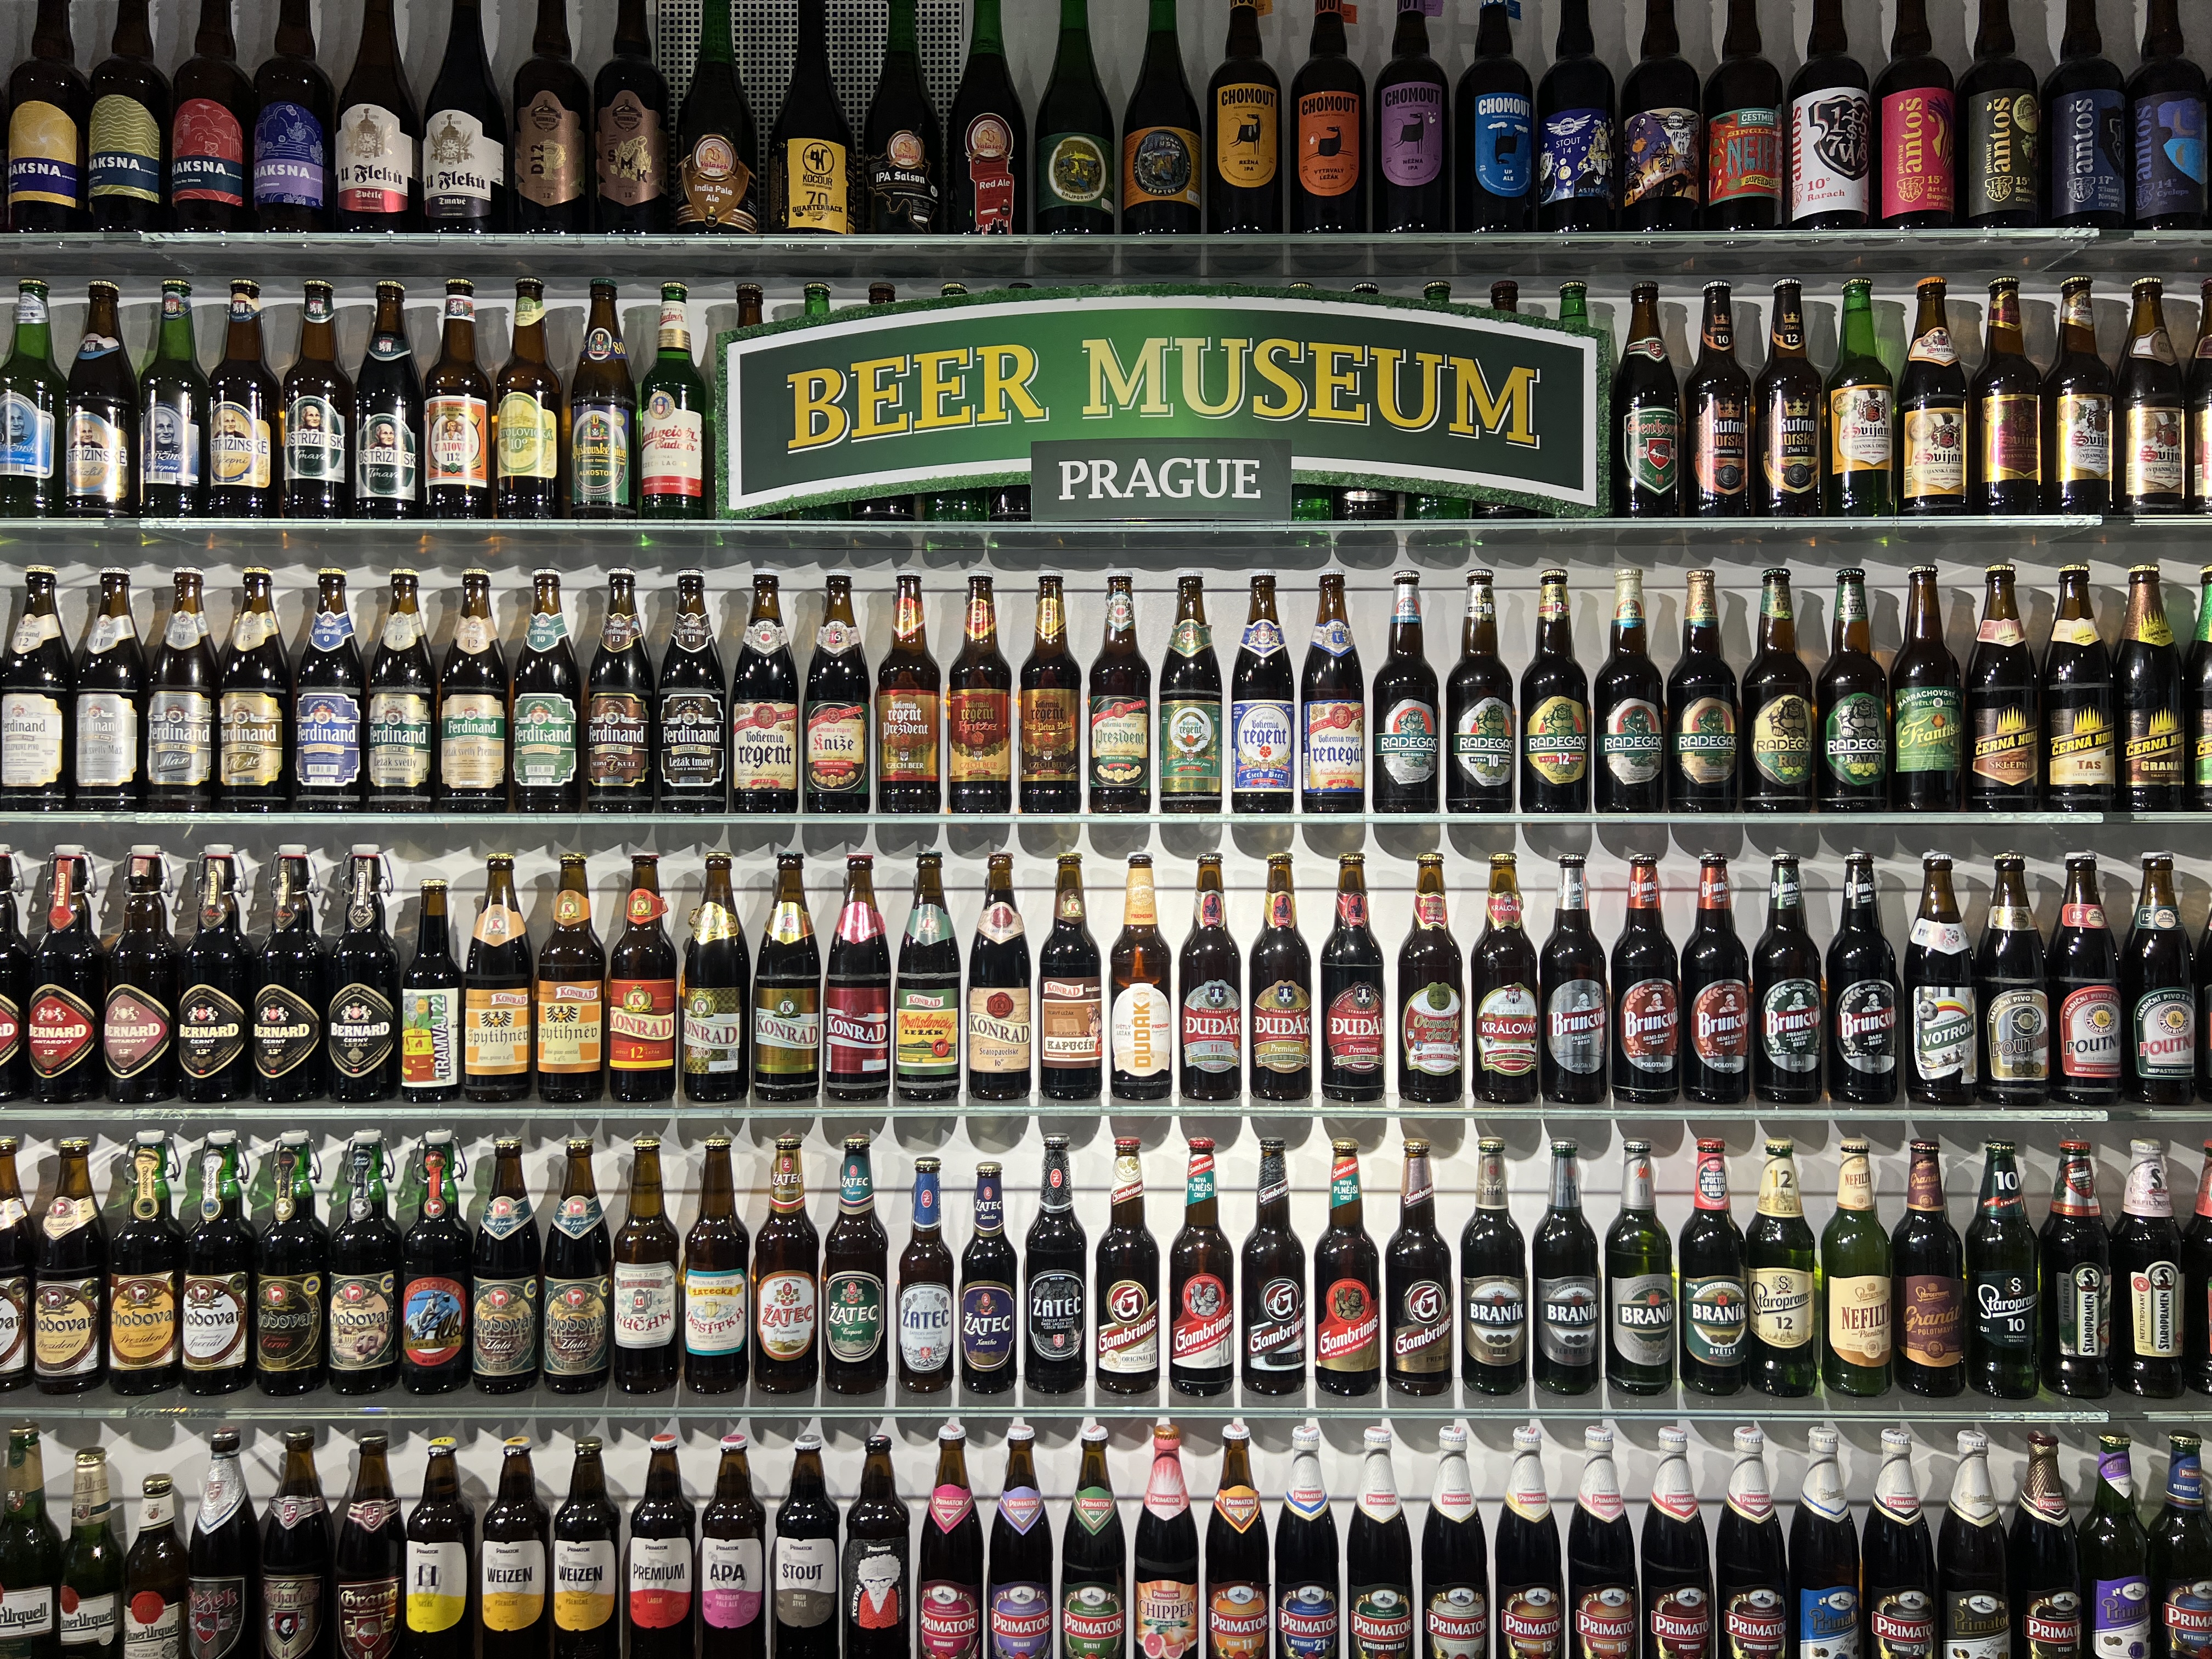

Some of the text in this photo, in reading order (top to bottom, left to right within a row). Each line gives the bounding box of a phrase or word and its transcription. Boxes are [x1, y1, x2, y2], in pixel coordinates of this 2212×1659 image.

[1221, 88, 1275, 107] CHOMOUT
[1385, 87, 1440, 106] CHOMOUT
[1302, 98, 1356, 116] CHOMOUT
[1478, 98, 1530, 117] CHOMOUT
[1556, 137, 1581, 148] STOUT
[803, 174, 833, 187] KOCOUR
[876, 172, 925, 184] IPA Saison
[979, 178, 1011, 189] Red Ale
[695, 184, 733, 196] India Pale
[706, 194, 719, 203] Ale
[1807, 190, 1846, 202] Rarach
[787, 336, 1542, 455] BEER MUSEUM
[446, 452, 460, 462] 11%
[1058, 458, 1261, 500] PRAGUE
[892, 701, 917, 710] Bohemia
[961, 706, 994, 721] regent
[1030, 707, 1064, 721] regent
[888, 708, 922, 722] regent
[149, 722, 210, 742] Ferdinand
[297, 723, 356, 743] Ferdinand
[448, 721, 496, 735] Ferdinand
[883, 722, 928, 737] Prezident
[1180, 725, 1201, 735] regent
[1252, 721, 1279, 729] Bohemia
[370, 724, 426, 744] Ferdinand
[515, 724, 571, 744] Ferdinand
[663, 725, 720, 745] Ferdinand
[746, 732, 783, 743] Bohemia
[1095, 729, 1145, 747] Prezident
[1243, 727, 1286, 746] regent
[813, 734, 855, 753] Kníže
[1976, 736, 2015, 755] ČERNÁ
[2052, 737, 2091, 756] ČERNÁ
[2126, 737, 2167, 757] ČERNÁ
[738, 744, 791, 769] regent
[1312, 742, 1363, 765] renegát
[1487, 754, 1499, 767] 10
[1557, 753, 1570, 765] 12
[2077, 760, 2101, 770] TAS
[1246, 771, 1264, 780] Czech
[560, 986, 595, 1000] KONRAD
[1047, 983, 1080, 996] KONRAD
[494, 994, 526, 1005] KONRAD
[909, 995, 941, 1007] KONRAD
[30, 1024, 86, 1038] BERNARD
[180, 1024, 239, 1038] BERNARD
[330, 1022, 389, 1036] BERNARD
[610, 1010, 673, 1038] KONRAD
[756, 1017, 817, 1045] KONRAD
[827, 1017, 887, 1043] KONRAD
[969, 1014, 1029, 1045] KONRAD
[1186, 1016, 1240, 1036] DUDÁK
[1255, 1016, 1311, 1036] DUDÁK
[1331, 1016, 1384, 1036] DUDÁK
[1414, 1014, 1459, 1031] Otavský
[1482, 1019, 1537, 1035] KRÁLOVÁK
[1551, 1009, 1606, 1036] Bruncvík
[432, 995, 451, 1079] TRAMVAJ 22
[1132, 1002, 1151, 1067] DUDÁK
[1424, 1026, 1452, 1042] zlatý
[1923, 1021, 1973, 1047] VOTROK
[1047, 1039, 1094, 1050] KAPUCÍN
[1210, 1043, 1223, 1053] 11%
[1270, 1044, 1300, 1053] Premium
[1348, 1044, 1377, 1054] Premium
[763, 1303, 813, 1327] ŽATEC
[828, 1301, 878, 1324] ŽATEC
[1034, 1295, 1081, 1318] ŽATEC
[1470, 1301, 1523, 1321] BRANÍK
[1548, 1301, 1598, 1321] BRANÍK
[1692, 1302, 1746, 1321] BRANÍK
[902, 1307, 949, 1329] ŽATEC
[964, 1312, 1011, 1336] ŽATEC
[1622, 1306, 1673, 1325] BRANÍK
[1776, 1317, 1792, 1329] 12
[1905, 1305, 1960, 1331] Granát
[2083, 1293, 2095, 1353] STAROPRAMEN
[2158, 1292, 2169, 1350] STAROPRAMEN
[840, 1328, 862, 1336] Export
[1099, 1314, 1156, 1350] Gambrinus
[1175, 1311, 1233, 1350] Gambrinus
[1250, 1314, 1306, 1351] Gambrinus
[1320, 1314, 1379, 1353] Gambrinus
[1918, 1325, 1954, 1336] POLOTMAVÝ
[2007, 1318, 2025, 1332] 10
[975, 1338, 997, 1346] Xantho
[1395, 1316, 1452, 1354] Gambrinus
[1149, 1353, 1156, 1364] 10
[1709, 1346, 1736, 1355] SVĚTLÝ
[487, 1566, 533, 1583] WEIZEN
[558, 1565, 602, 1582] WEIZEN
[634, 1563, 685, 1580] PREMIUM
[710, 1564, 746, 1581] APA
[782, 1563, 823, 1580] STOUT
[2, 1602, 47, 1628] Urquell
[1139, 1600, 1194, 1619] CHIPPER
[78, 1607, 115, 1631] Urquell
[145, 1620, 179, 1641] Urquell
[1242, 1639, 1252, 1649] 11
[1315, 1639, 1325, 1650] 21
[1617, 1642, 1627, 1652] 16
[1913, 1644, 1925, 1656] 24
